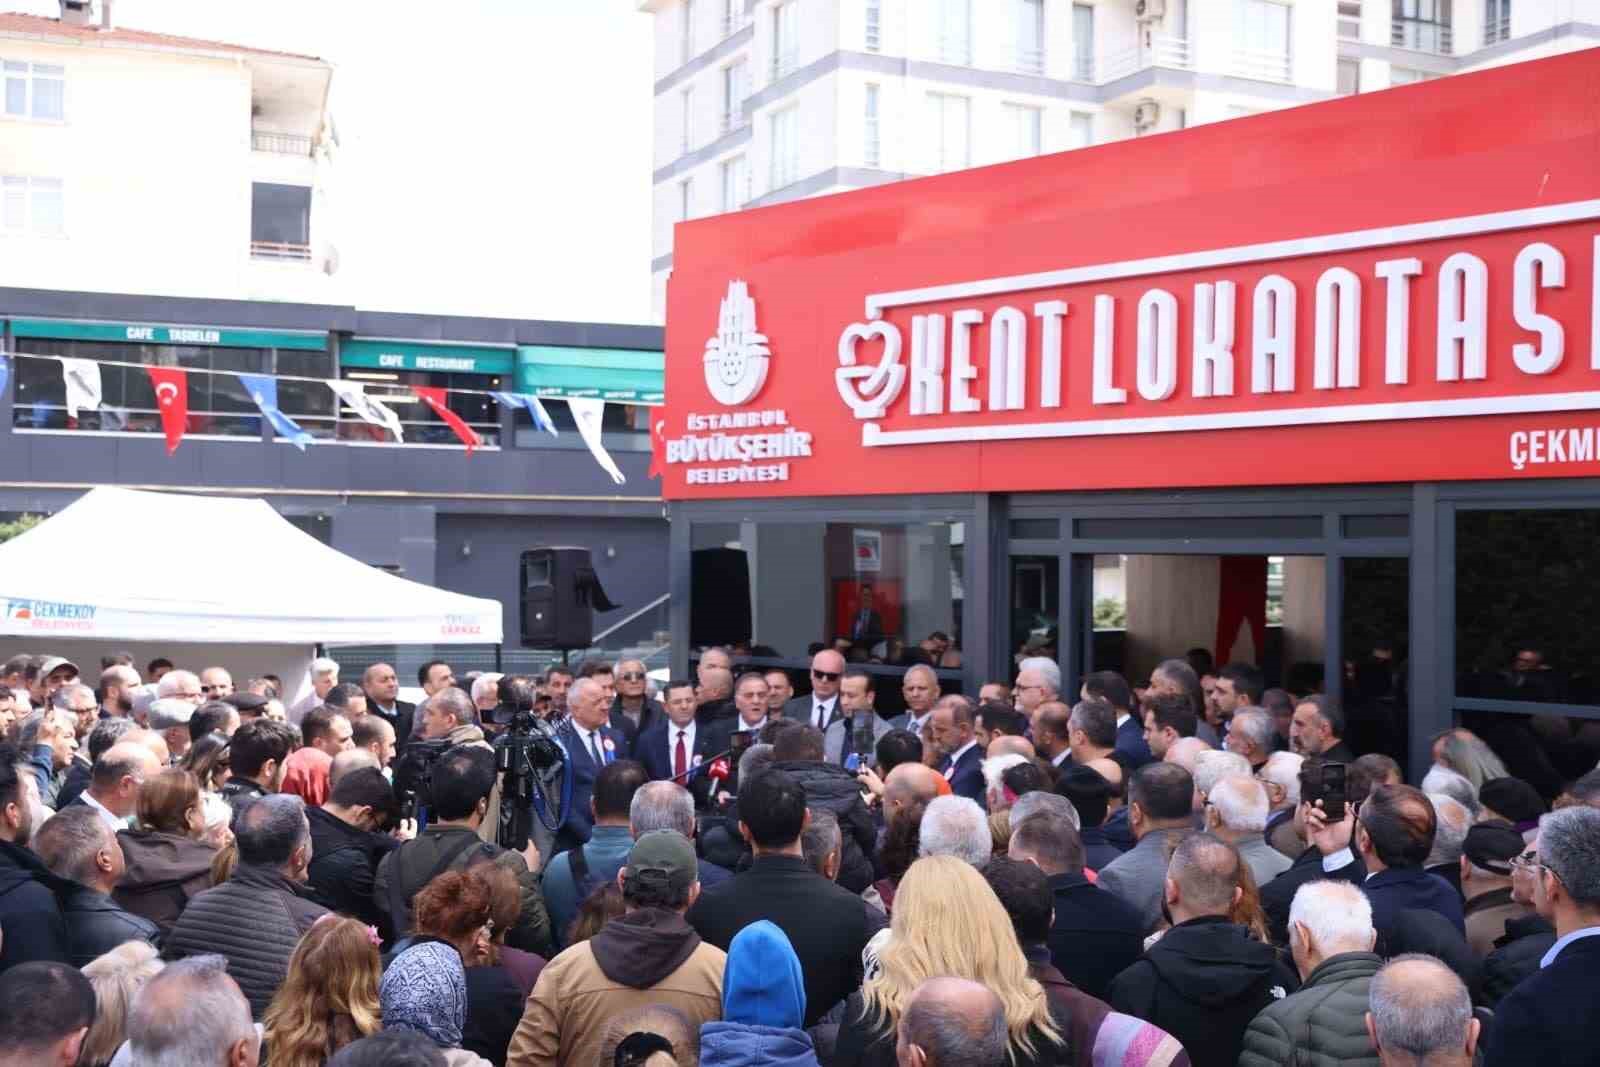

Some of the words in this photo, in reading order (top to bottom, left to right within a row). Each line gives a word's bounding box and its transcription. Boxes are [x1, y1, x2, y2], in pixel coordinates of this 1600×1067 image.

[126, 326, 154, 340] CAFE
[379, 354, 404, 367] CAFE
[909, 300, 1068, 416] KENT
[687, 409, 788, 431] İSTANBUL
[666, 427, 812, 464] BÜYÜKŞEHİR
[1510, 427, 1600, 470] ÇEKM
[686, 462, 789, 484] BELEDİYESİ
